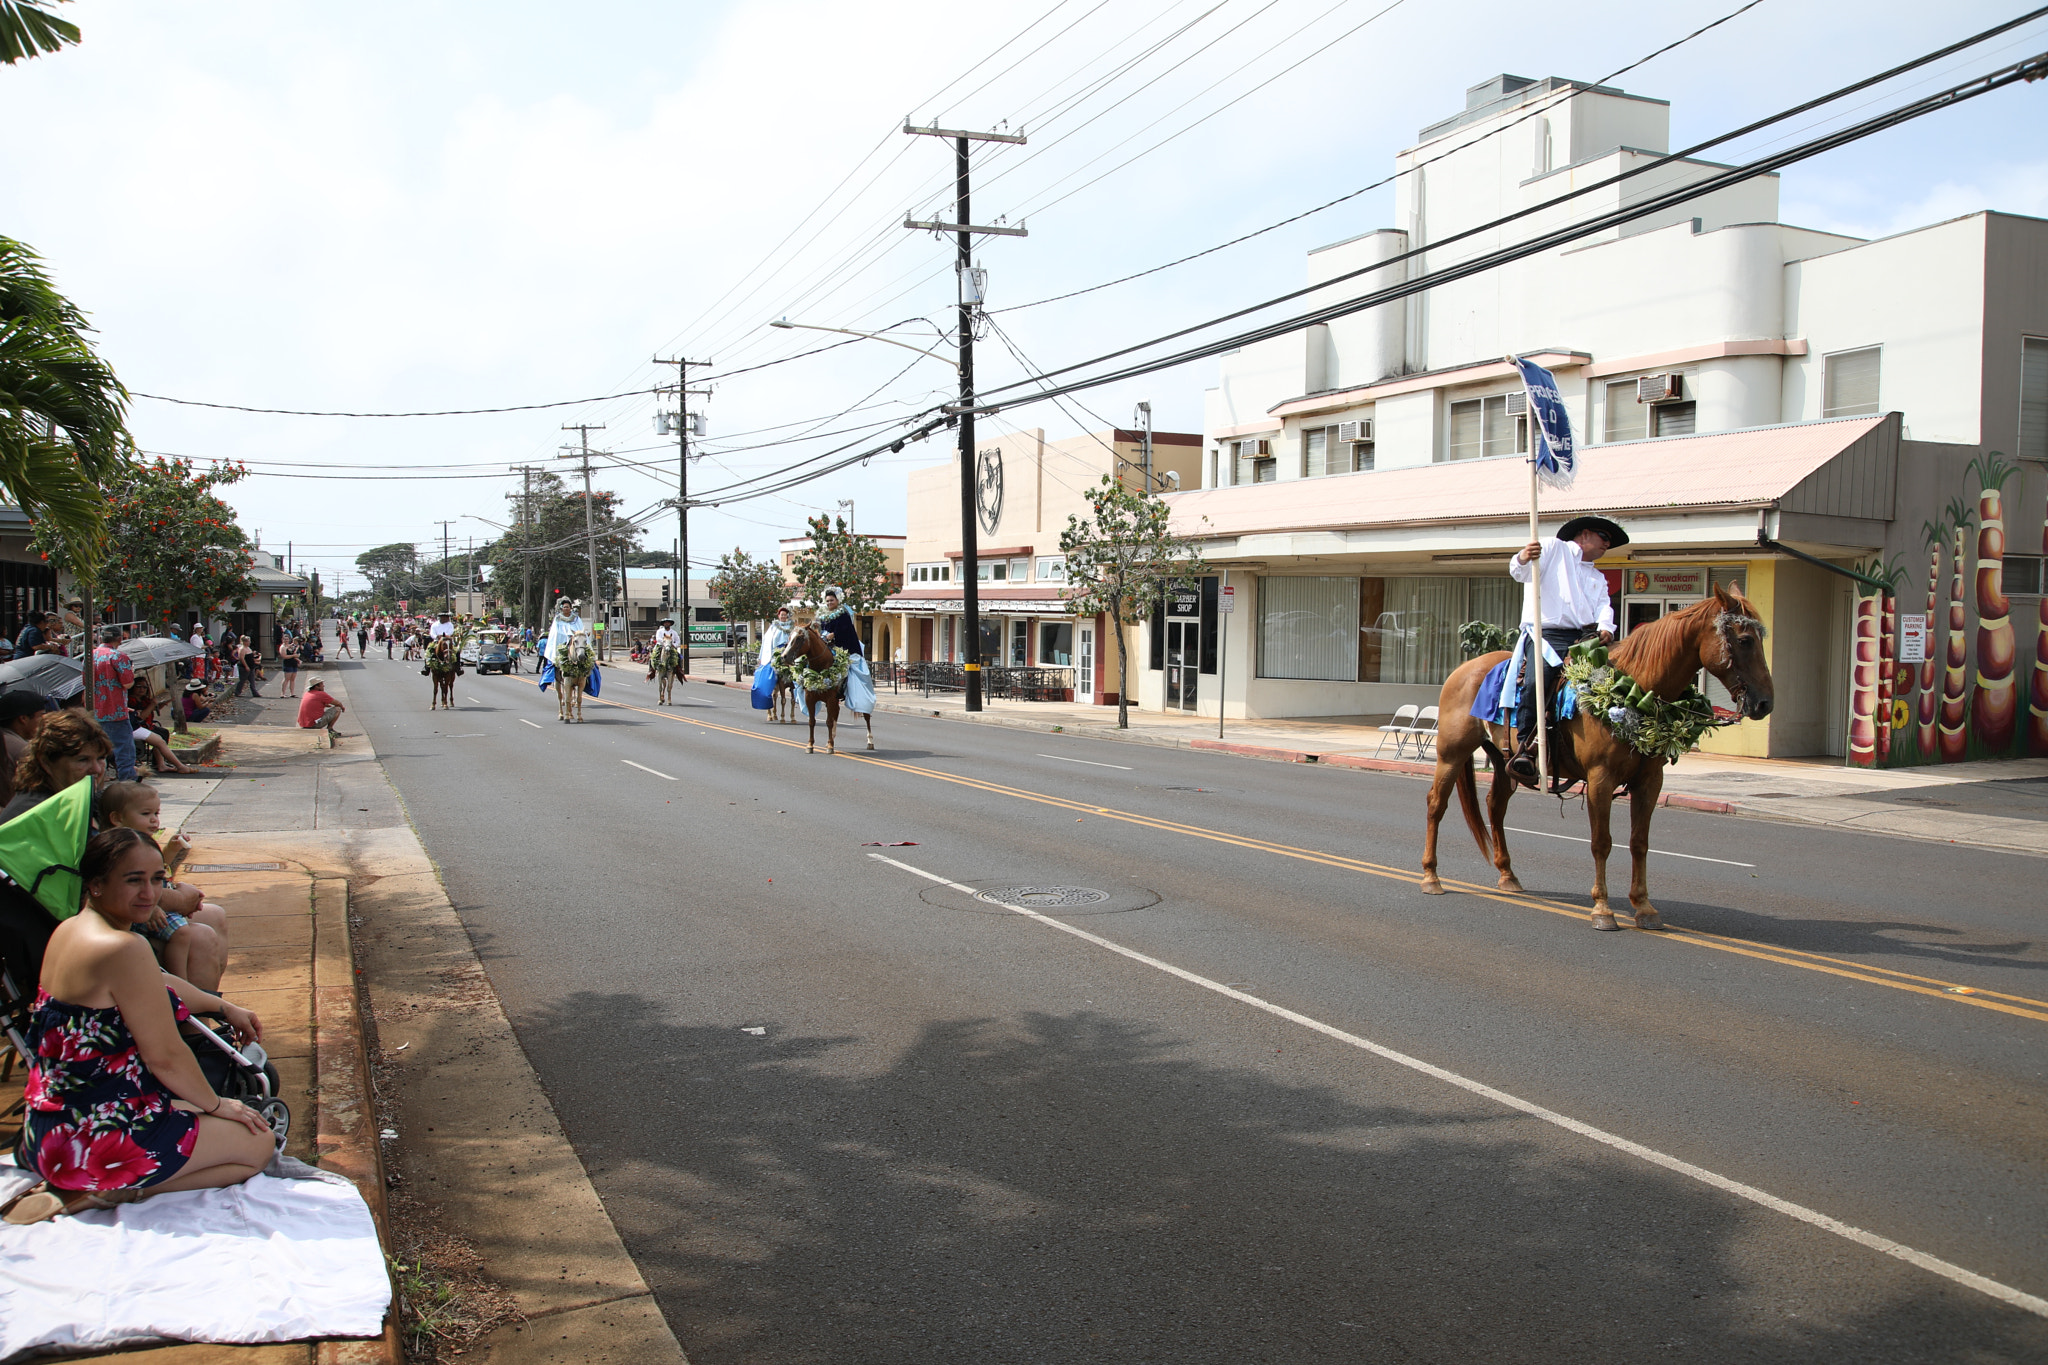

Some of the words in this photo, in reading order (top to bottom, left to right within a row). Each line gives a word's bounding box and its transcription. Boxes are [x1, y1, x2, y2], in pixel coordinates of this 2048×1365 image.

[1654, 573, 1698, 582] Kawakami
[1177, 604, 1192, 612] SHOP
[690, 633, 722, 641] TOKIOKA
